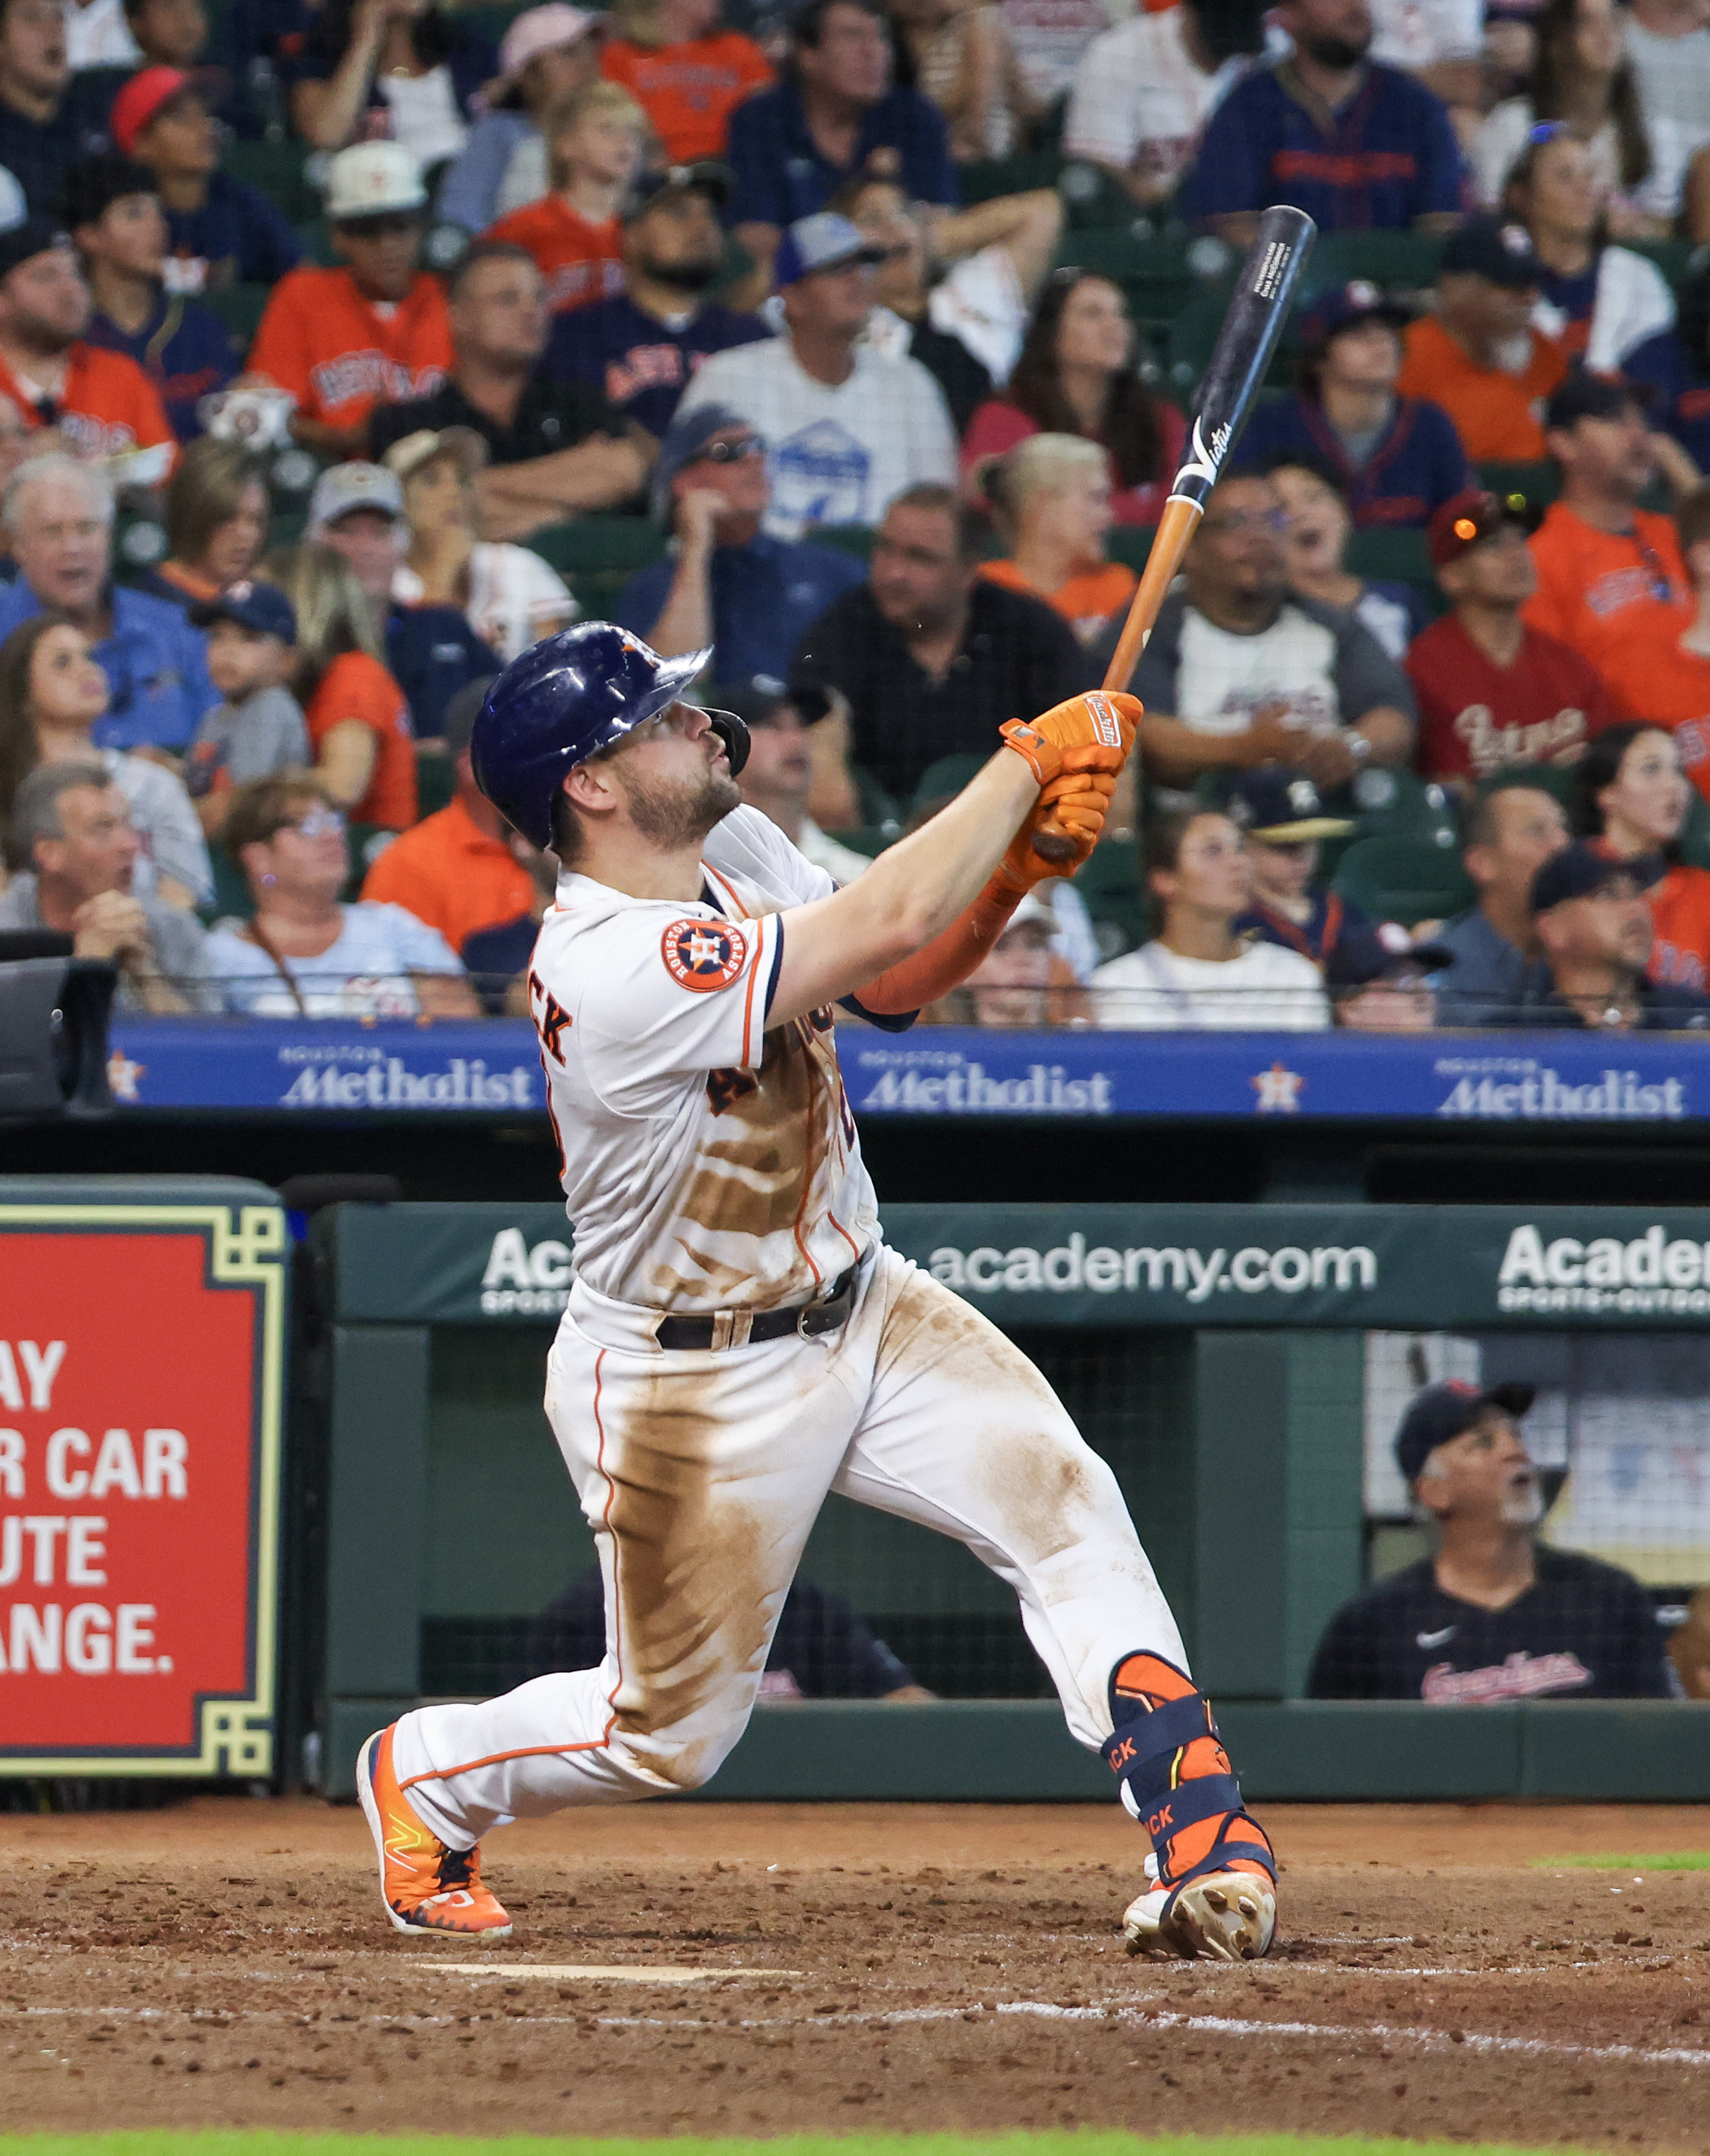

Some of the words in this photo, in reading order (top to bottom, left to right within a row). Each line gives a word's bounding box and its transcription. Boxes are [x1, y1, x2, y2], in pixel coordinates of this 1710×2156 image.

[1171, 415, 1233, 487] Victus
[666, 920, 691, 979] HOUSTON
[722, 928, 745, 980] ASTROS
[281, 1057, 532, 1107] Methodist
[863, 1062, 1111, 1112] Methodist
[1436, 1068, 1683, 1118] Methodist
[929, 1232, 1377, 1302] academy.com
[1497, 1224, 1710, 1287] Acade
[45, 1427, 189, 1500] CAR
[0, 1602, 174, 1675] NGE.
